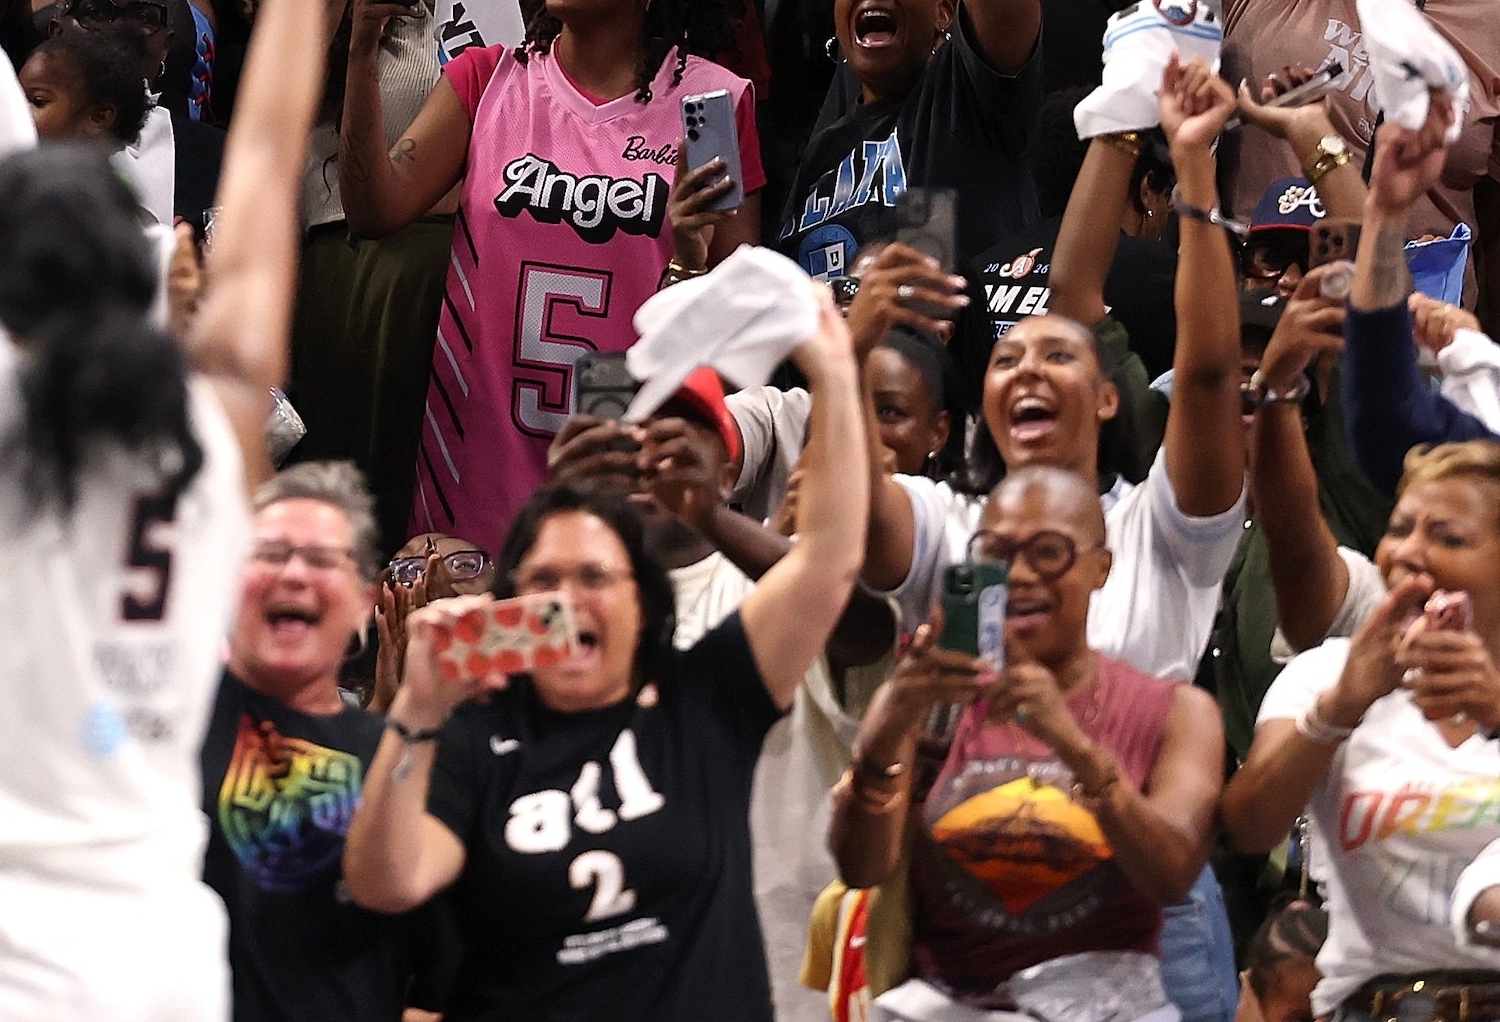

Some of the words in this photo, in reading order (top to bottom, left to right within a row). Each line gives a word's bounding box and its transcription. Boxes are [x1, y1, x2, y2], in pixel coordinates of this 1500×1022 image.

[496, 154, 660, 230] Angel
[511, 260, 614, 440] 5
[120, 490, 180, 622] 5
[504, 728, 667, 855] atl
[567, 849, 639, 925] 2
